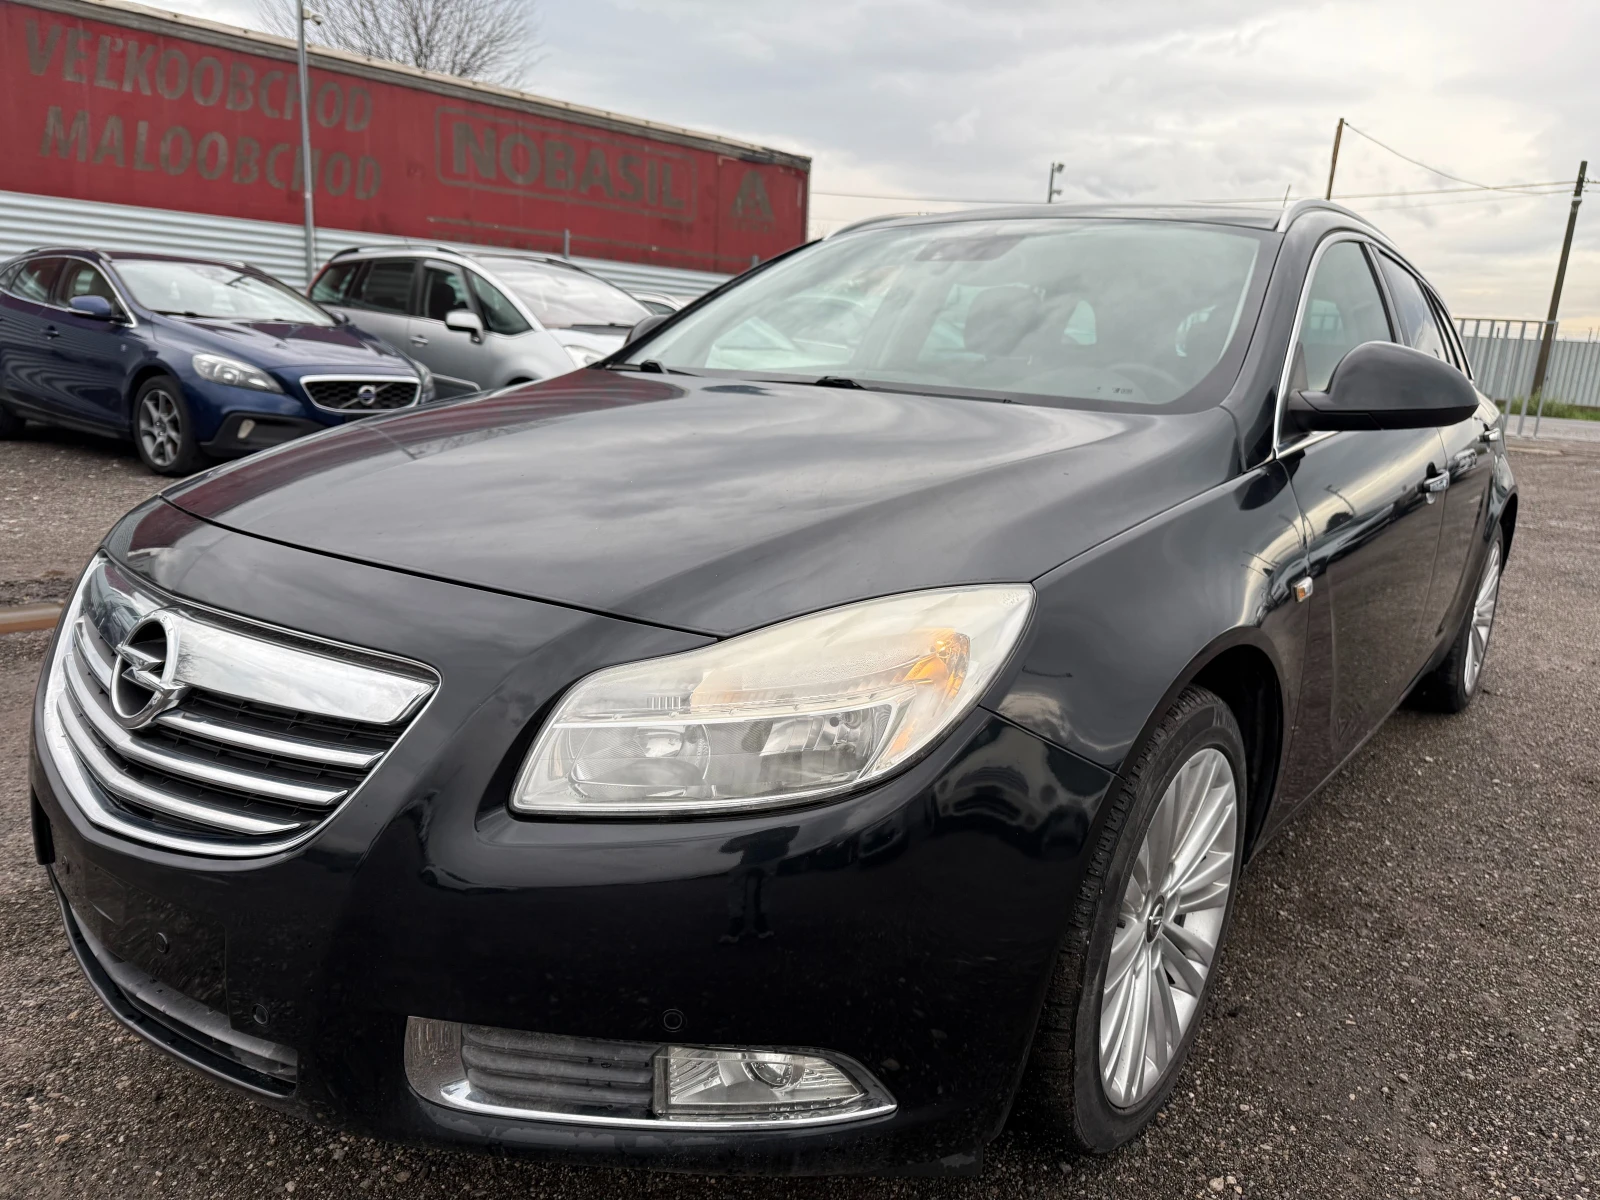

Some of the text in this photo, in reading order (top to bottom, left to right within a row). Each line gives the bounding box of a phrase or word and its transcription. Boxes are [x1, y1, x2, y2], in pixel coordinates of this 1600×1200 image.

[25, 19, 373, 131] VEĽKOOBCHOD
[39, 105, 381, 200] MALOOBCHOD
[452, 123, 683, 209] NOBASIL
